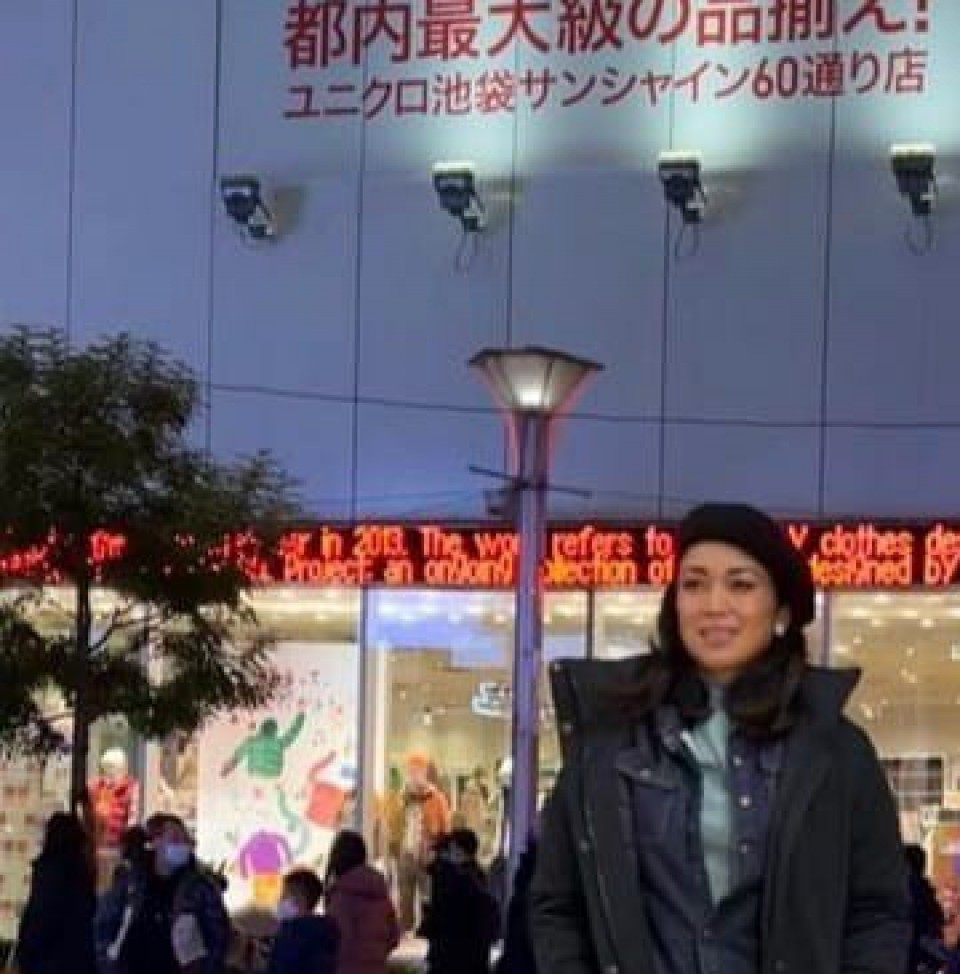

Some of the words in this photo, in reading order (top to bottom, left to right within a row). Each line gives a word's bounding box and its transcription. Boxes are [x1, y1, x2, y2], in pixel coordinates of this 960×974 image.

[284, 47, 928, 119] ユニクロ池袋サンシャイン60通り店
[419, 525, 463, 556] The
[552, 525, 633, 556] refers
[646, 525, 675, 556] to
[821, 523, 913, 555] clothes
[536, 553, 637, 585] ollection
